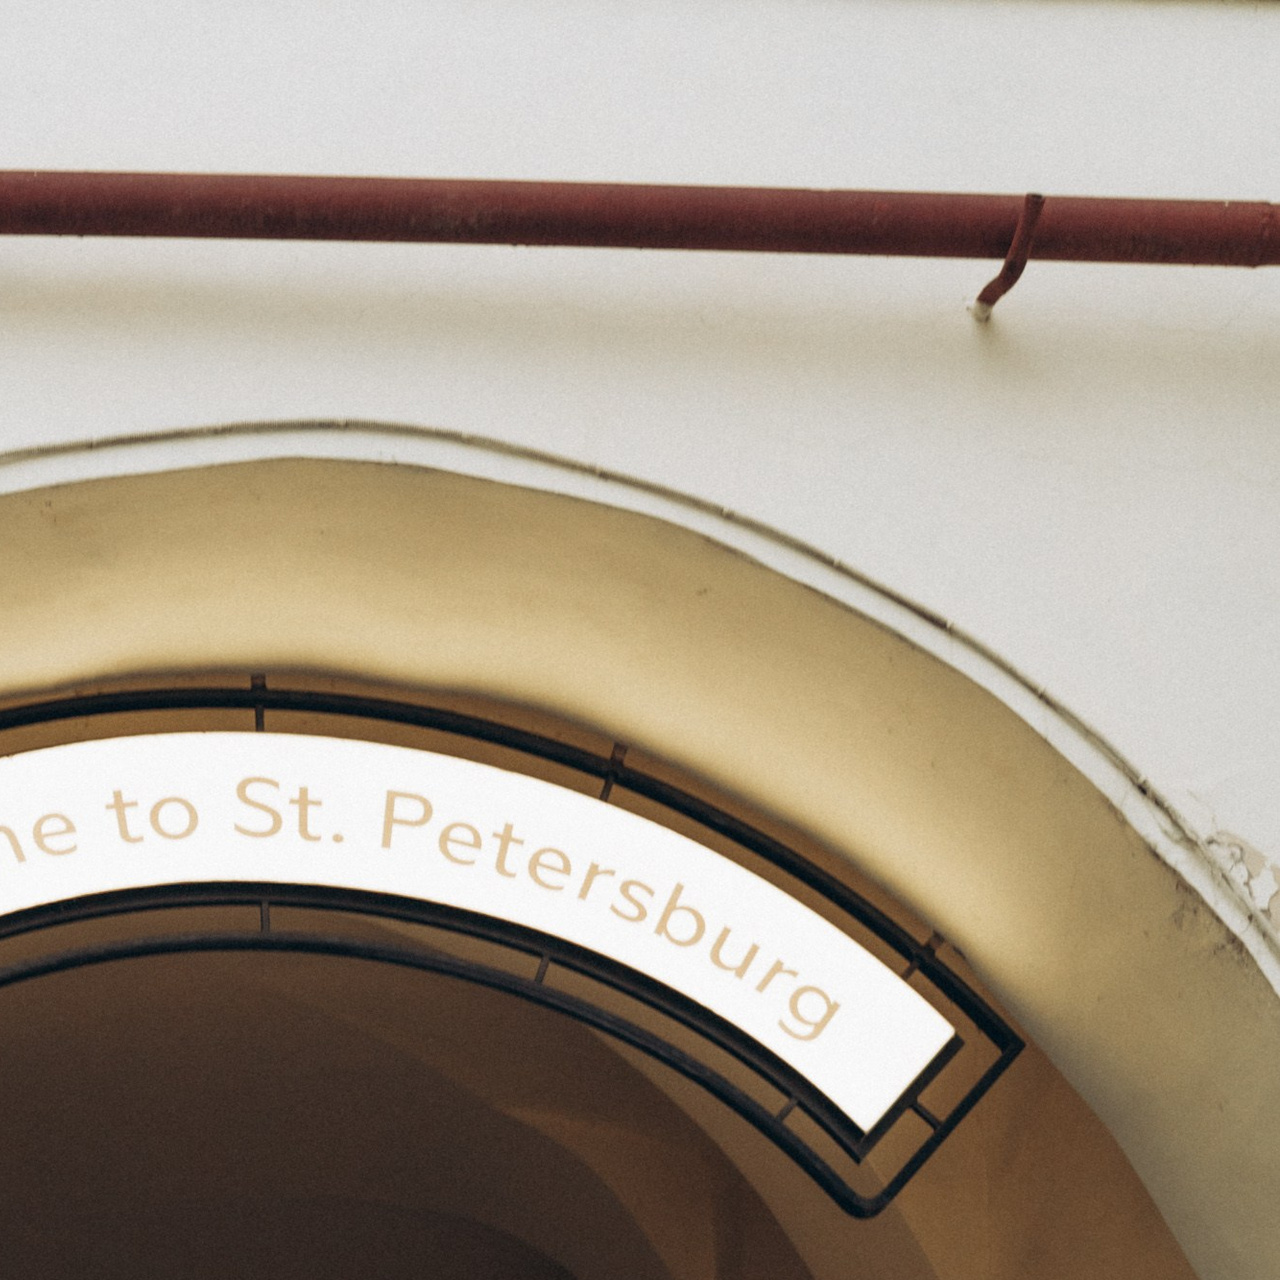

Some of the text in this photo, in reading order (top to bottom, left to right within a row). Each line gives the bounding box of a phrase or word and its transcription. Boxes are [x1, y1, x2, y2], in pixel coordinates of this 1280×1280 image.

[104, 787, 200, 845] to
[233, 775, 344, 845] St.
[380, 788, 841, 1043] Petersburg
